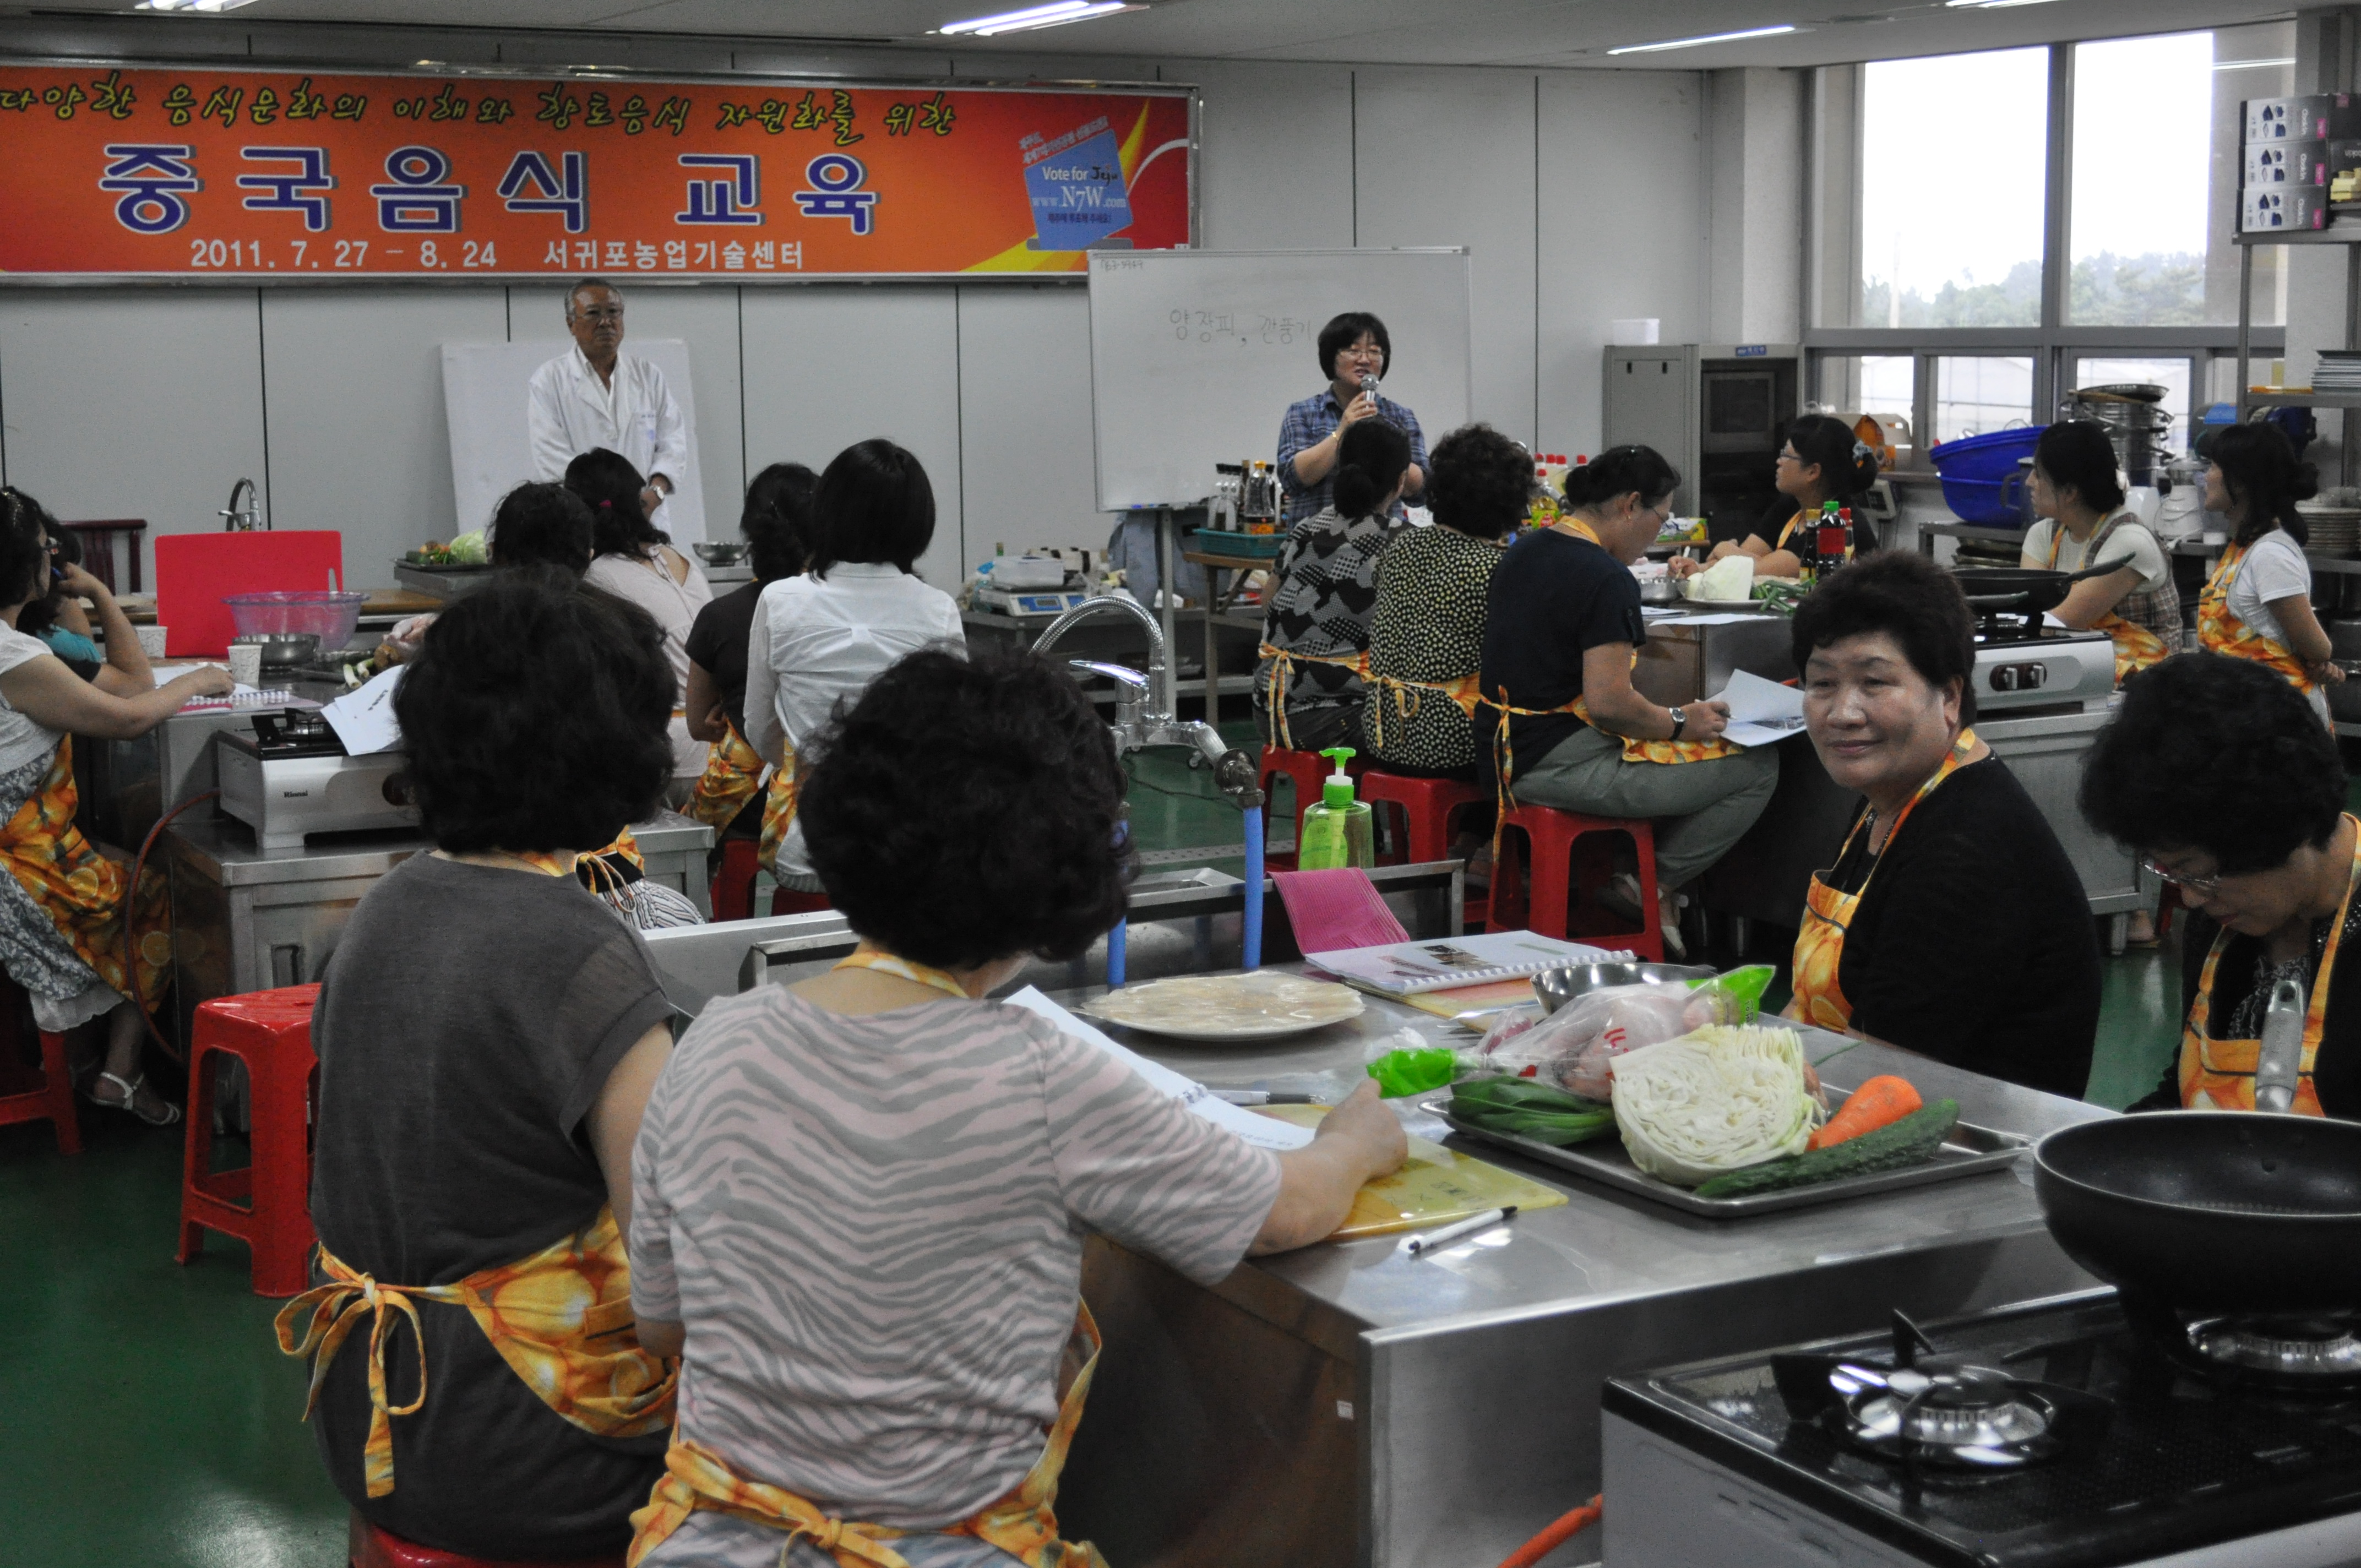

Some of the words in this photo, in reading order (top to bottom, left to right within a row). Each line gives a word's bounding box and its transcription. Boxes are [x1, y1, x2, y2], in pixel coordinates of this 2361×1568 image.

[0, 72, 134, 119] 다양한
[164, 79, 365, 126] 음식문화의
[395, 85, 513, 122] 이해와
[537, 84, 690, 134] 향토음식
[717, 91, 863, 145] 자원화를
[885, 92, 955, 135] 위한
[1042, 167, 1070, 181] Vote
[1071, 166, 1089, 181] for
[543, 240, 803, 269] 서귀포농업기술센터
[284, 790, 308, 798] Rinnai
